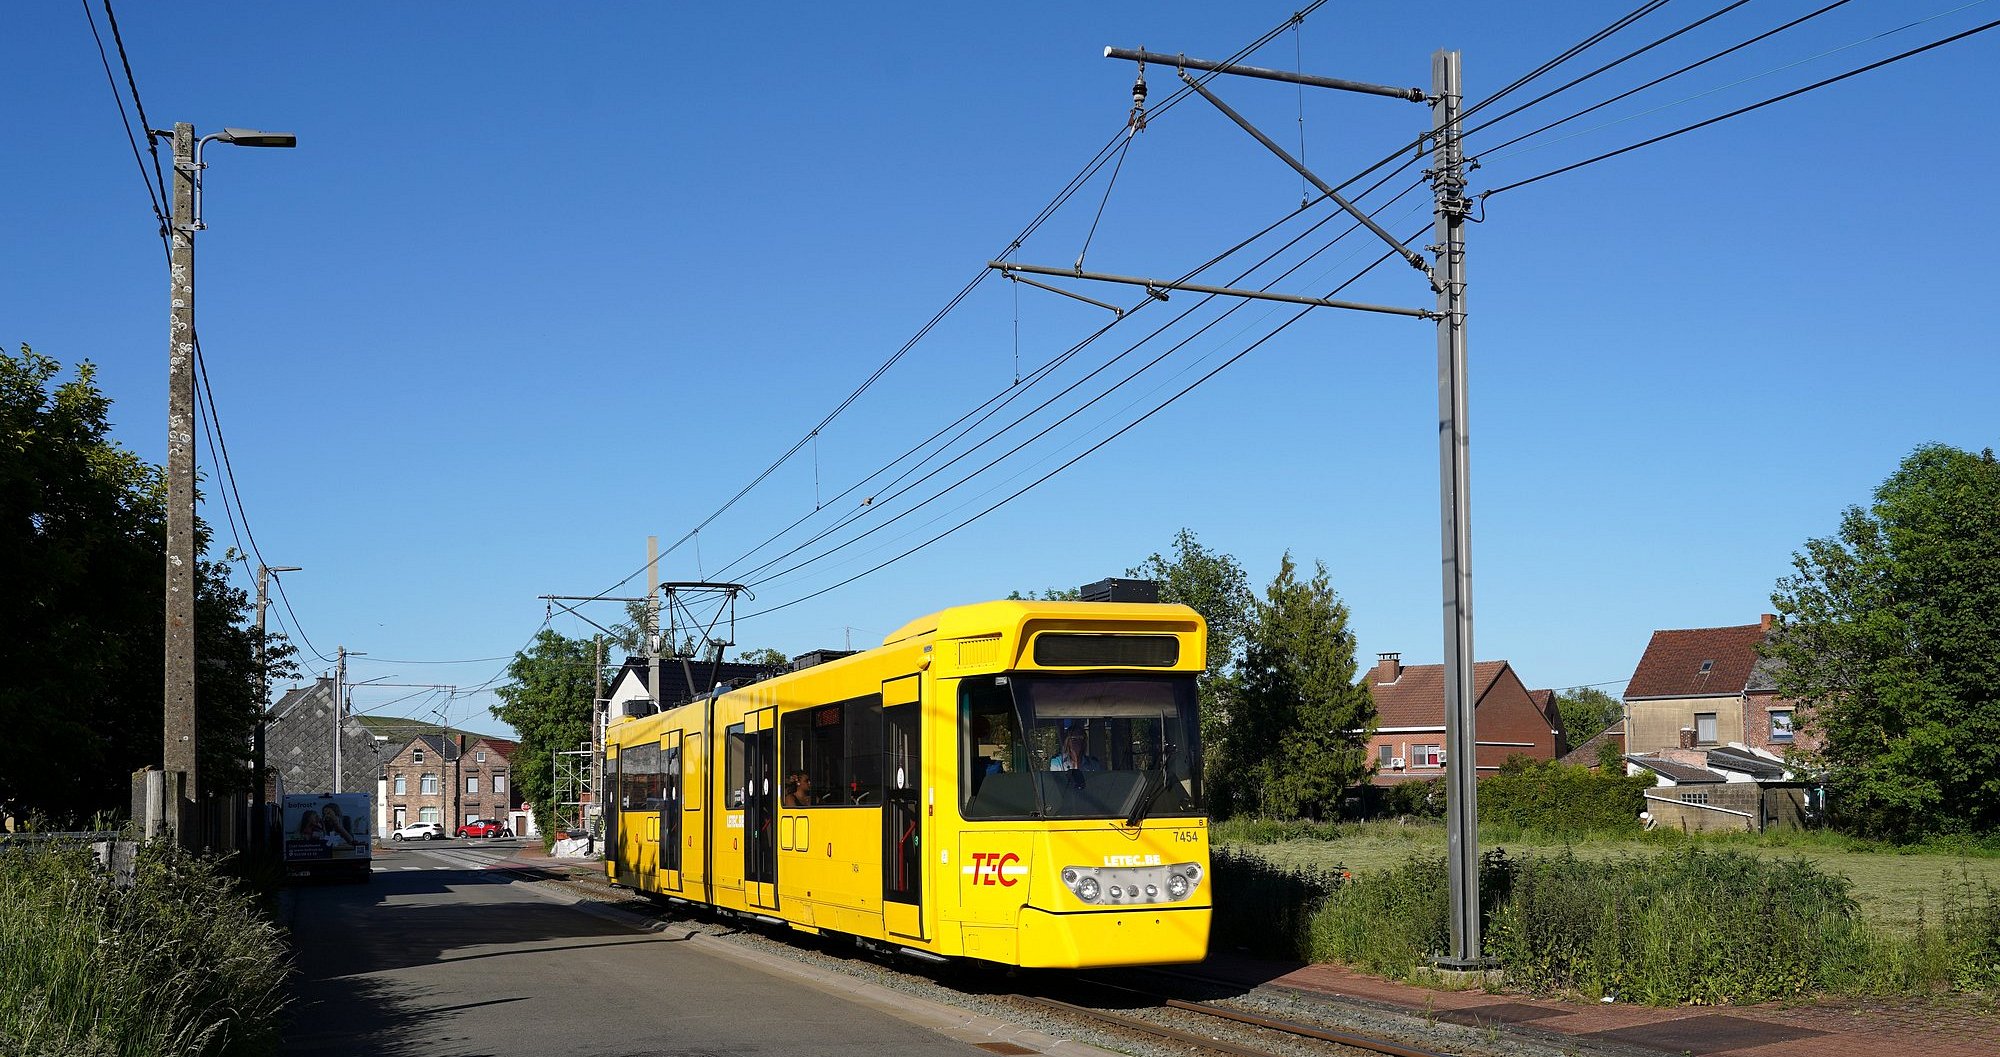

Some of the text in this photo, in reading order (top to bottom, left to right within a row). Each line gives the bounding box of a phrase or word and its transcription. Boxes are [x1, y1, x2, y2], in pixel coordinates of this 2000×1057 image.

[1173, 831, 1198, 843] 7454
[1104, 854, 1161, 867] LETEC.BE
[972, 852, 1020, 887] TEC
